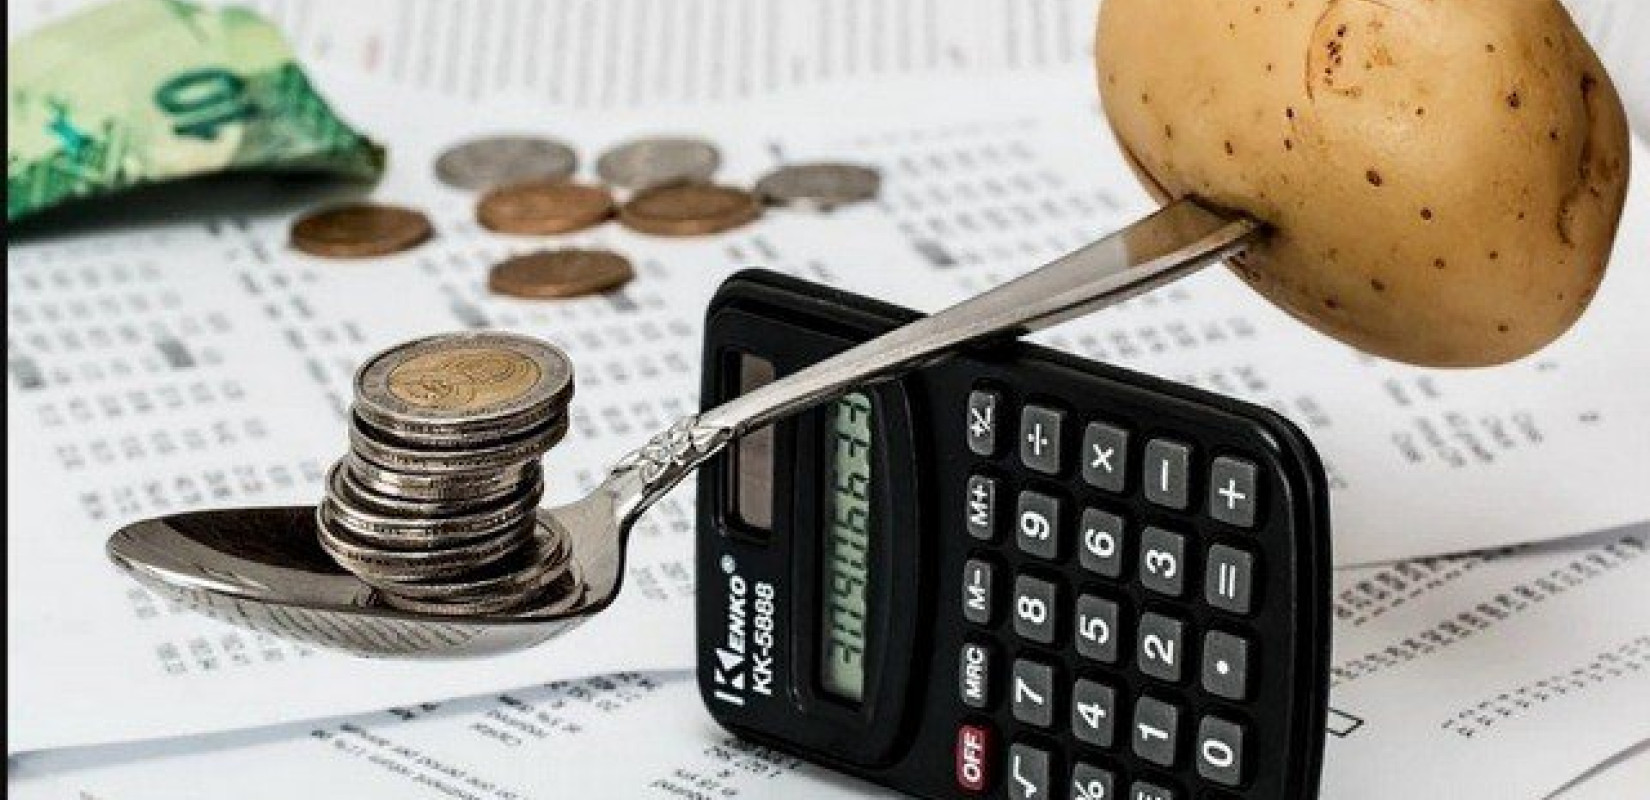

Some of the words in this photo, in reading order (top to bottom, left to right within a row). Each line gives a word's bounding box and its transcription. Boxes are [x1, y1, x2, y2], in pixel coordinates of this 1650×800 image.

[970, 484, 989, 526] M+
[1020, 511, 1050, 541] 9
[1084, 528, 1115, 559] 6
[1146, 549, 1177, 579] 3
[967, 569, 986, 610] M-
[1017, 595, 1047, 626] 8
[752, 581, 775, 696] KK-5888
[1079, 614, 1110, 644] 5
[1143, 634, 1175, 666] 2
[965, 647, 984, 699] MRC
[1015, 676, 1045, 706] 7
[1076, 701, 1107, 729] 4
[1137, 722, 1169, 742] 1
[963, 732, 983, 783] OFF
[1203, 740, 1234, 768] 0
